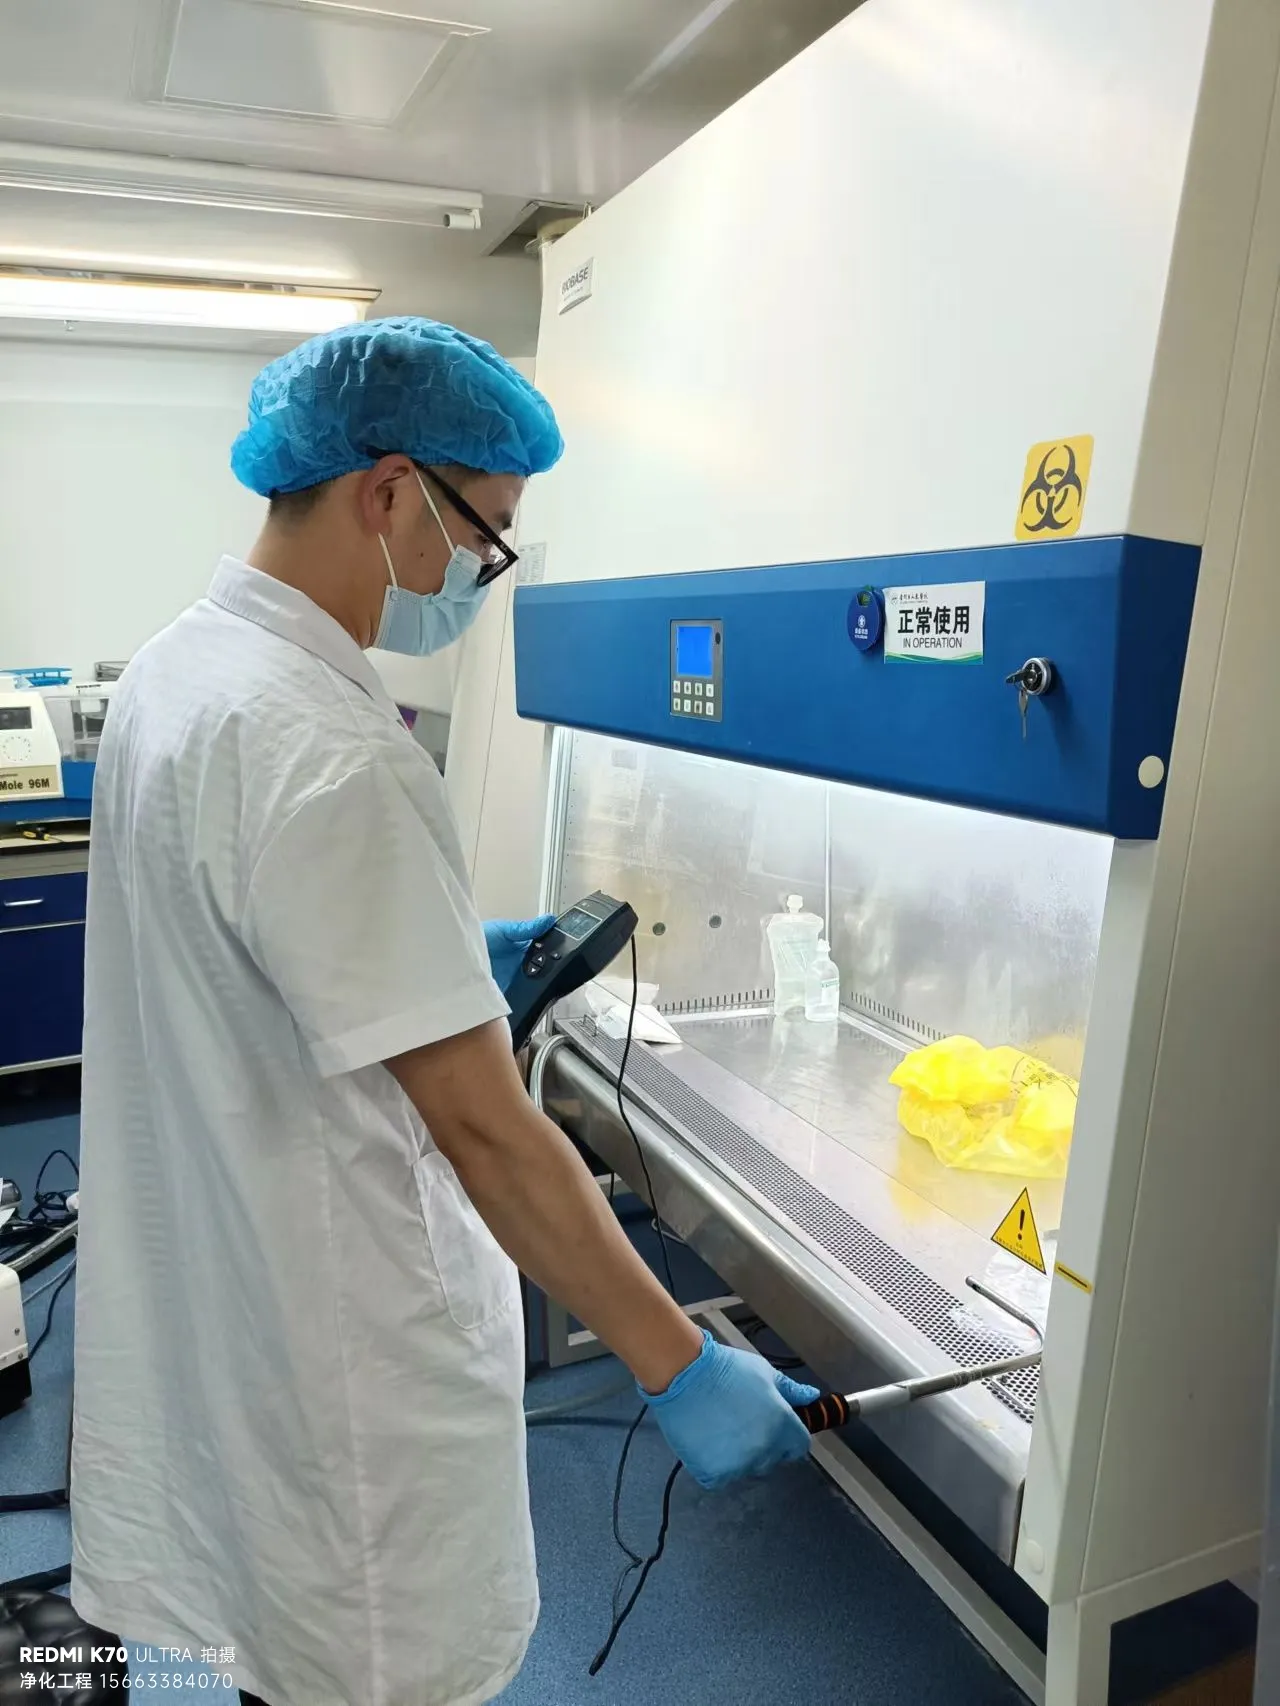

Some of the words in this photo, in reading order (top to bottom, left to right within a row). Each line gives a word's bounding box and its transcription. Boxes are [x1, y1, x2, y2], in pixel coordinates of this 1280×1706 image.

[897, 605, 970, 635] 正常使用
[903, 638, 911, 648] IN
[912, 637, 962, 648] OPERATION
[28, 778, 50, 789] 96M
